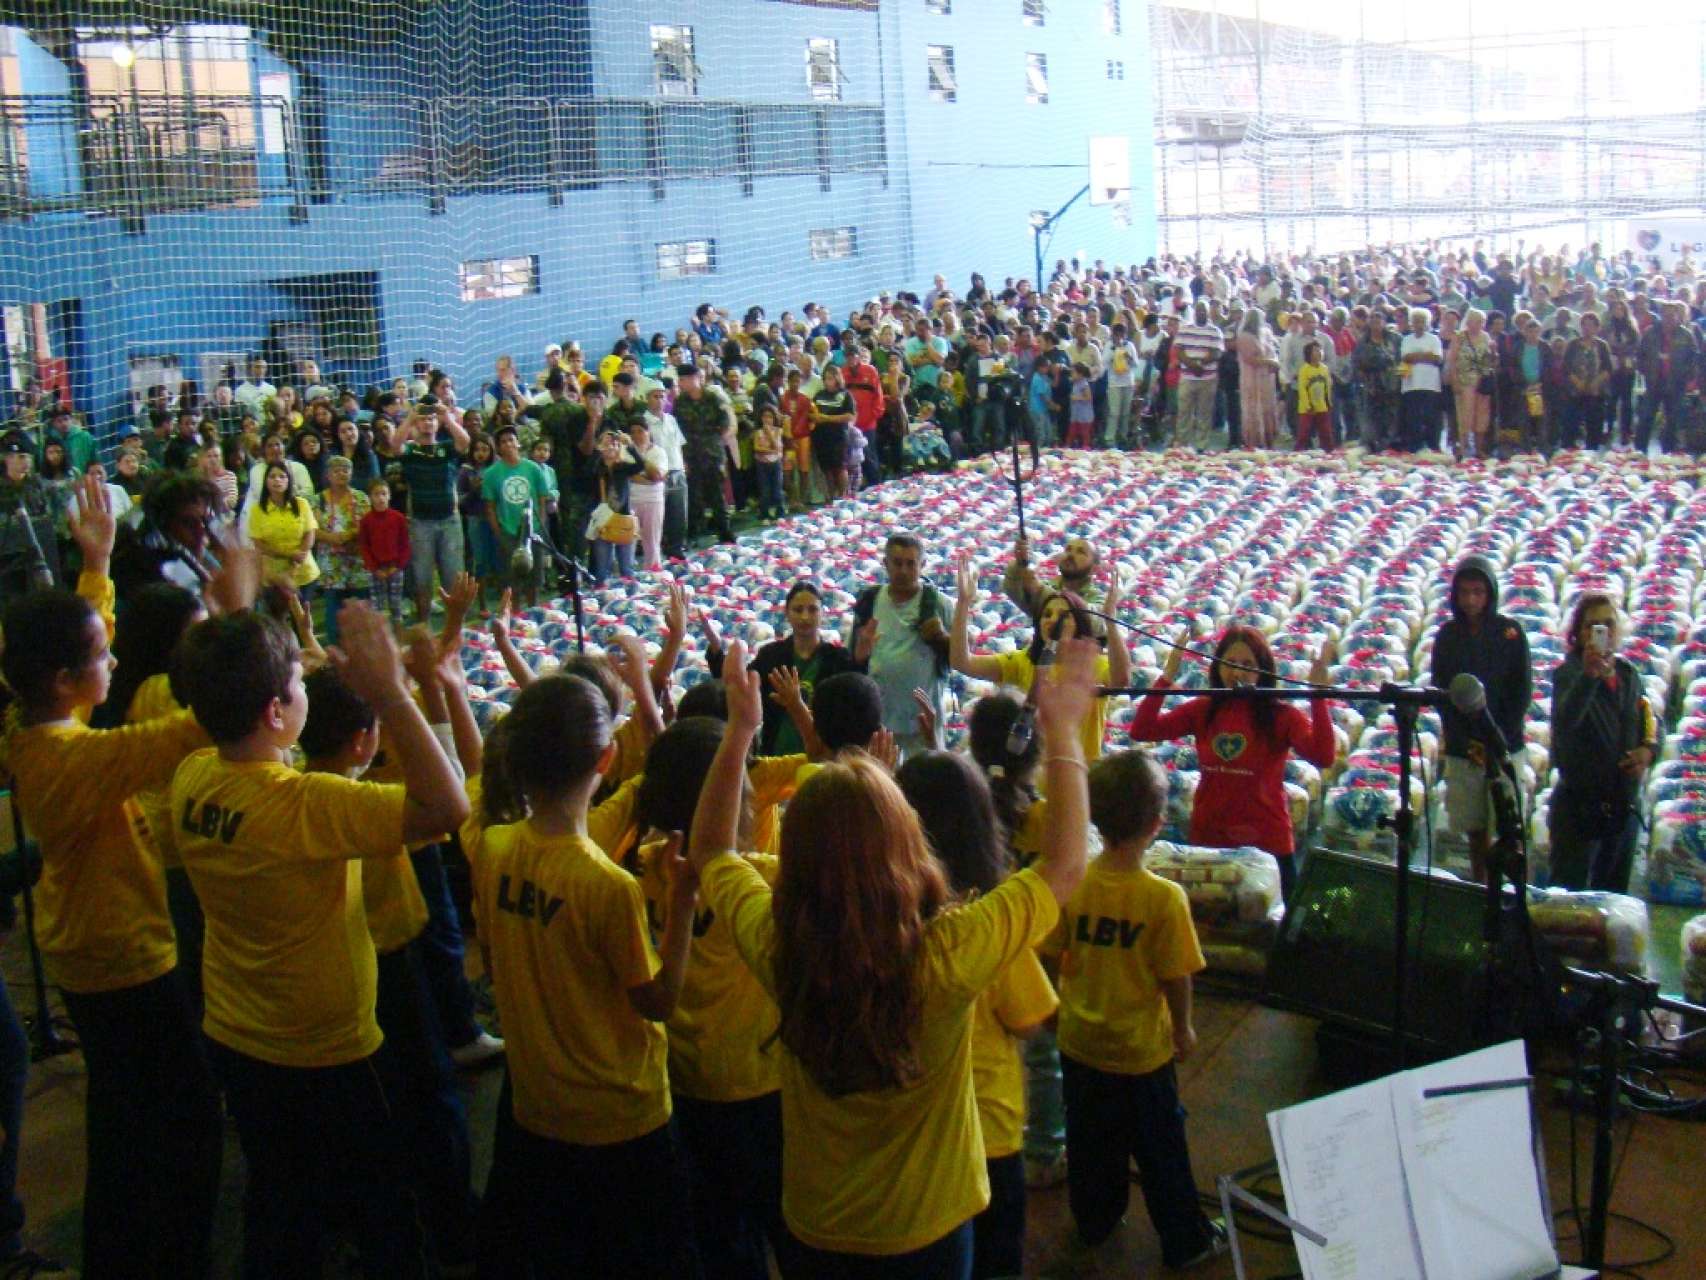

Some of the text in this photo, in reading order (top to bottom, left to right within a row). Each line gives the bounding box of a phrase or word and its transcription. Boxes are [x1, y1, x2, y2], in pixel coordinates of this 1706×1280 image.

[182, 797, 245, 845] LBV
[497, 874, 565, 928] LBV
[1076, 914, 1147, 949] LBV
